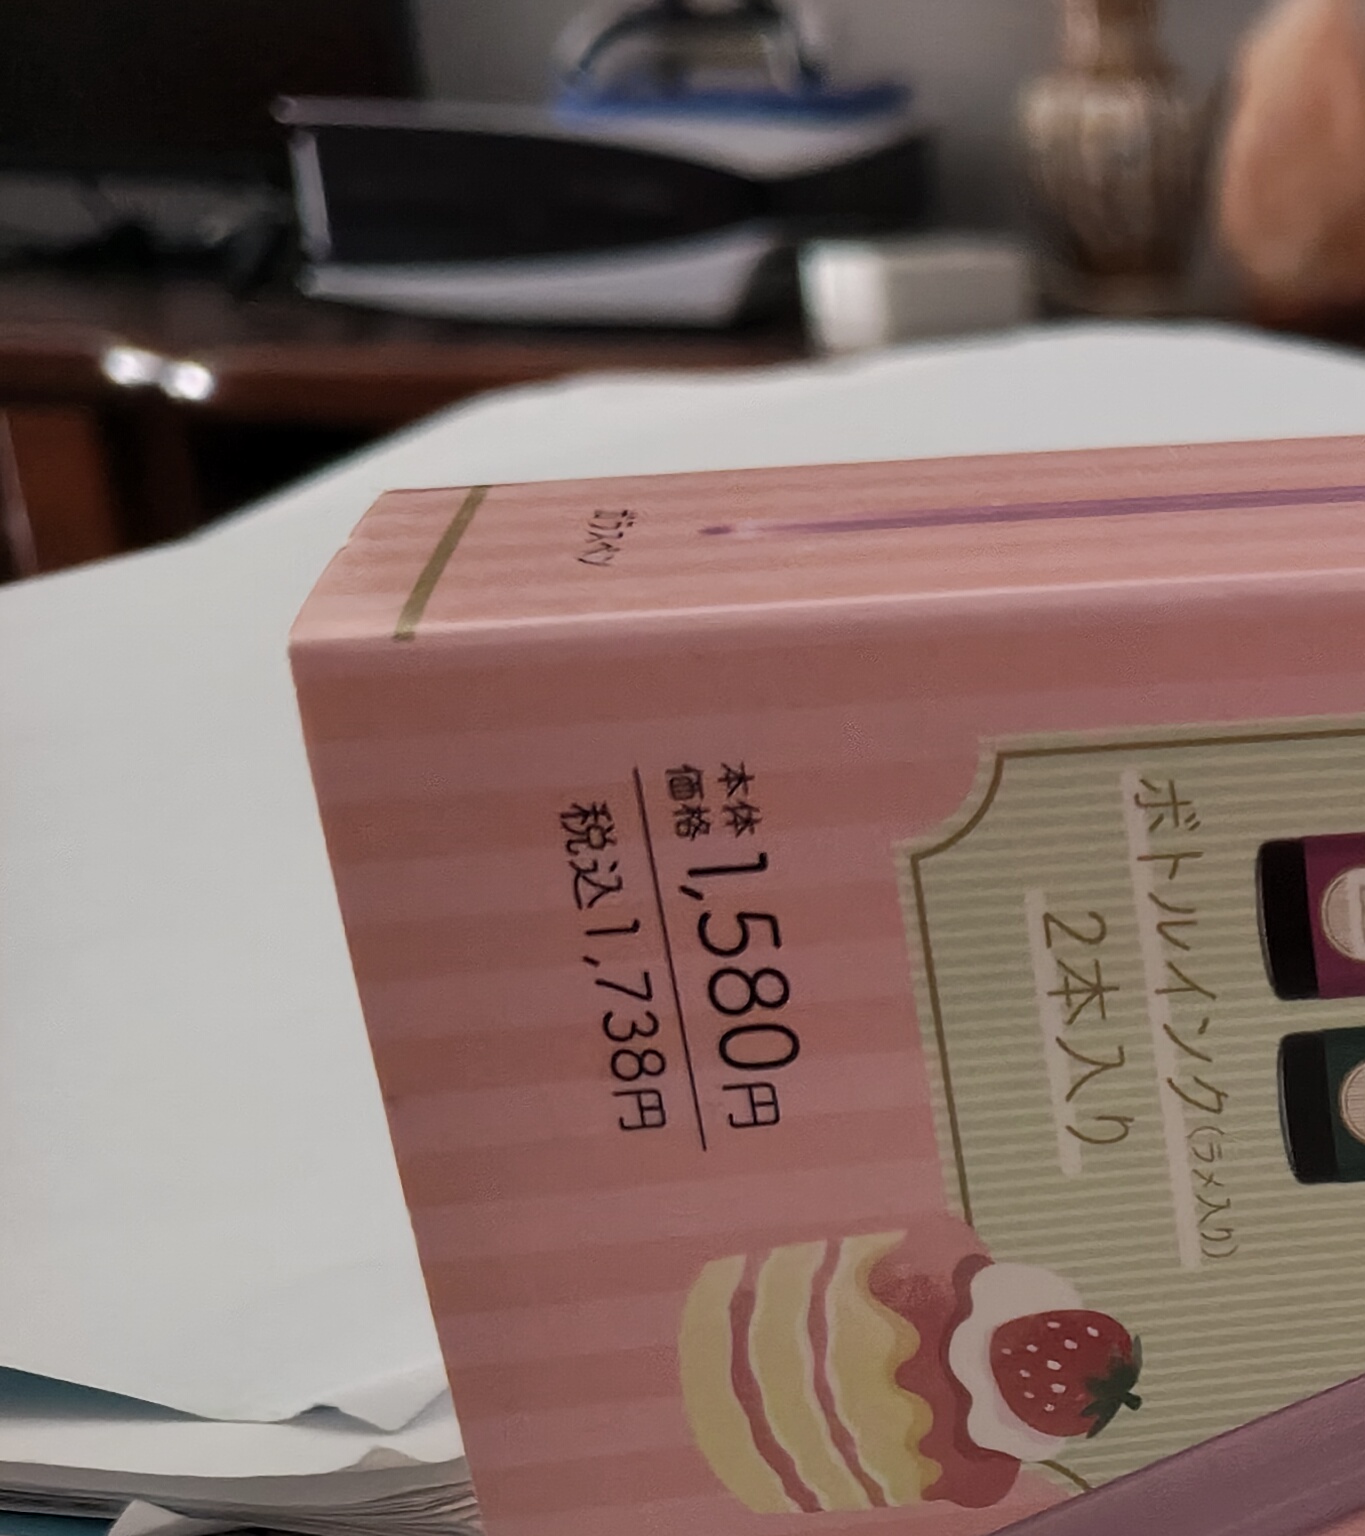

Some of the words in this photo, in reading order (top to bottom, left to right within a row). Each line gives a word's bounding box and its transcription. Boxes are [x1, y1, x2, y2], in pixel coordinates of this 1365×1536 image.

[664, 763, 711, 841] 価格
[718, 761, 762, 839] 本体
[679, 852, 800, 1129] 1,580円
[1042, 911, 1135, 1146] 2本入り
